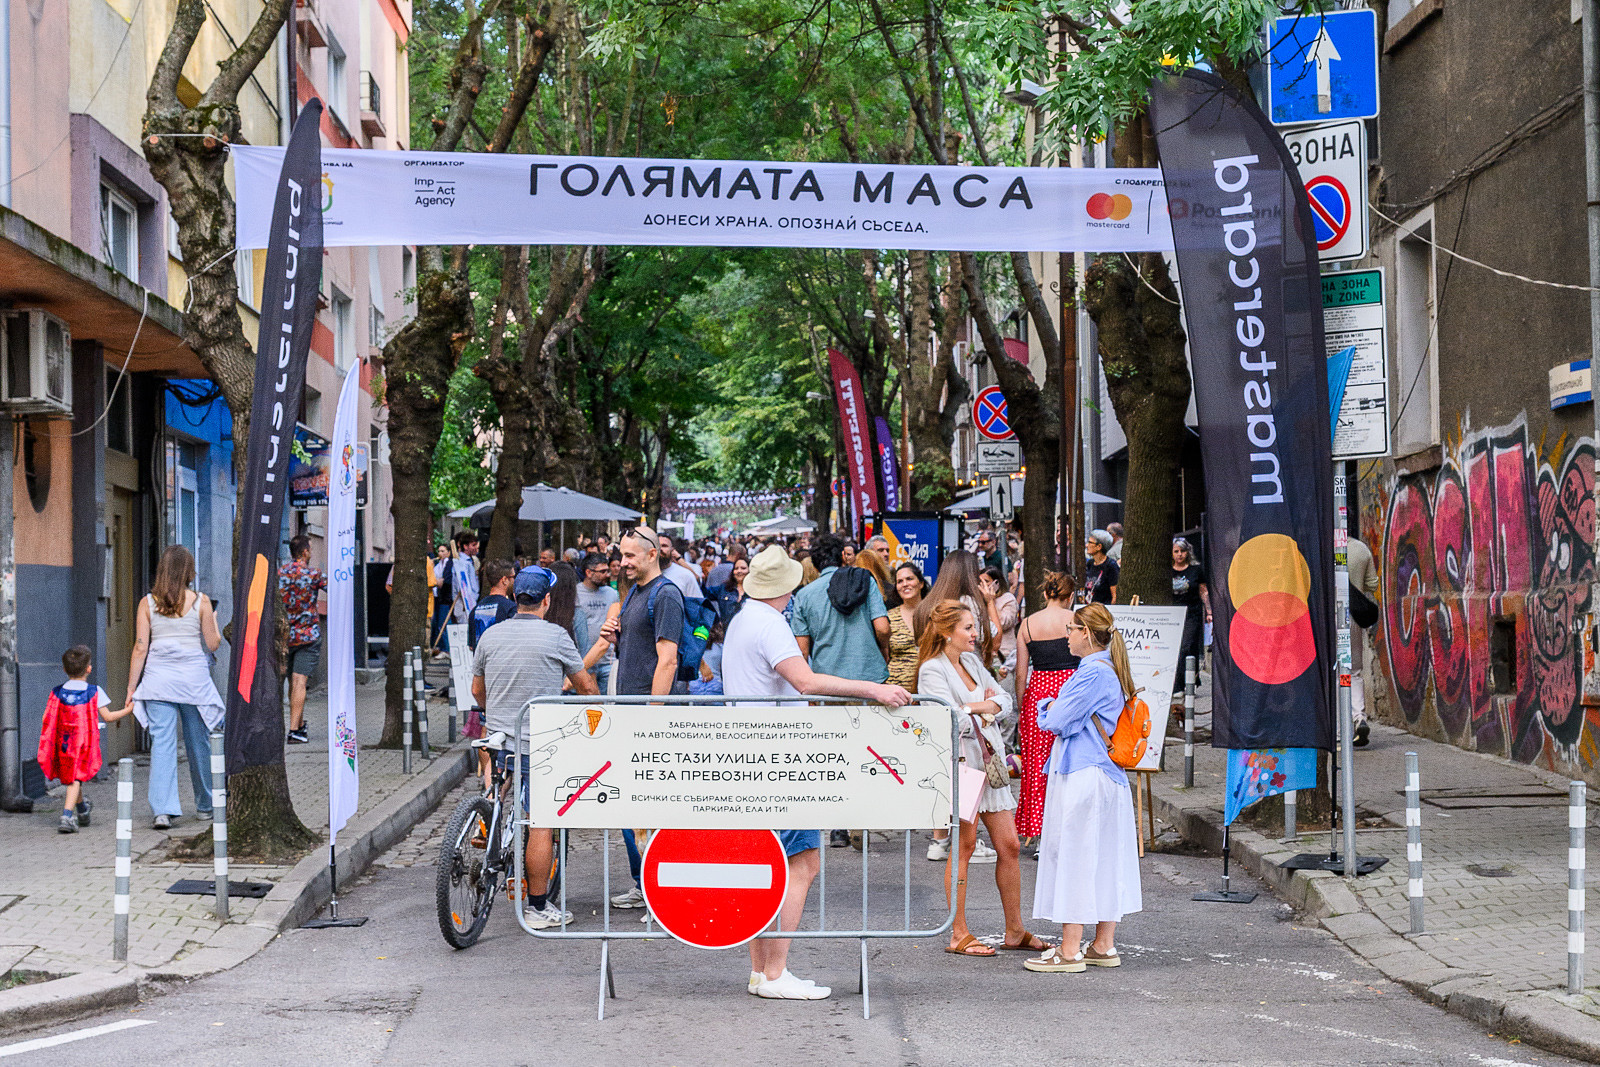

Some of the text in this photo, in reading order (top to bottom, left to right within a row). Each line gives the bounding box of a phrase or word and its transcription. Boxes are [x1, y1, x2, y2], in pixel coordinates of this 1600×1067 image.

[1289, 133, 1354, 166] ЗОНА
[414, 178, 435, 188] Imp
[529, 163, 1034, 210] ГОЛЯМАТА МАСА
[437, 186, 455, 195] Act
[415, 195, 455, 208] Agency
[643, 214, 929, 234] ДОНЕСИ ХРАНА. ОПОЗНАЙ СЪСЕДА.
[1086, 221, 1130, 229] mastercard
[1341, 277, 1370, 290] ЗОНА
[1338, 290, 1366, 302] ZONE
[1213, 154, 1285, 505] mastercard
[648, 732, 714, 740] АВТОМОБИЛИ,
[631, 752, 850, 766] ДНЕС ТАЗИ УЛИЦА Е ЗА ХОРА,
[634, 770, 847, 782] НЕ ЗА ПРЕВОЗНИ СРЕДСТВА
[631, 794, 668, 802] ВСИЧКИ
[692, 804, 744, 814] ПАРКИРАЙ,
